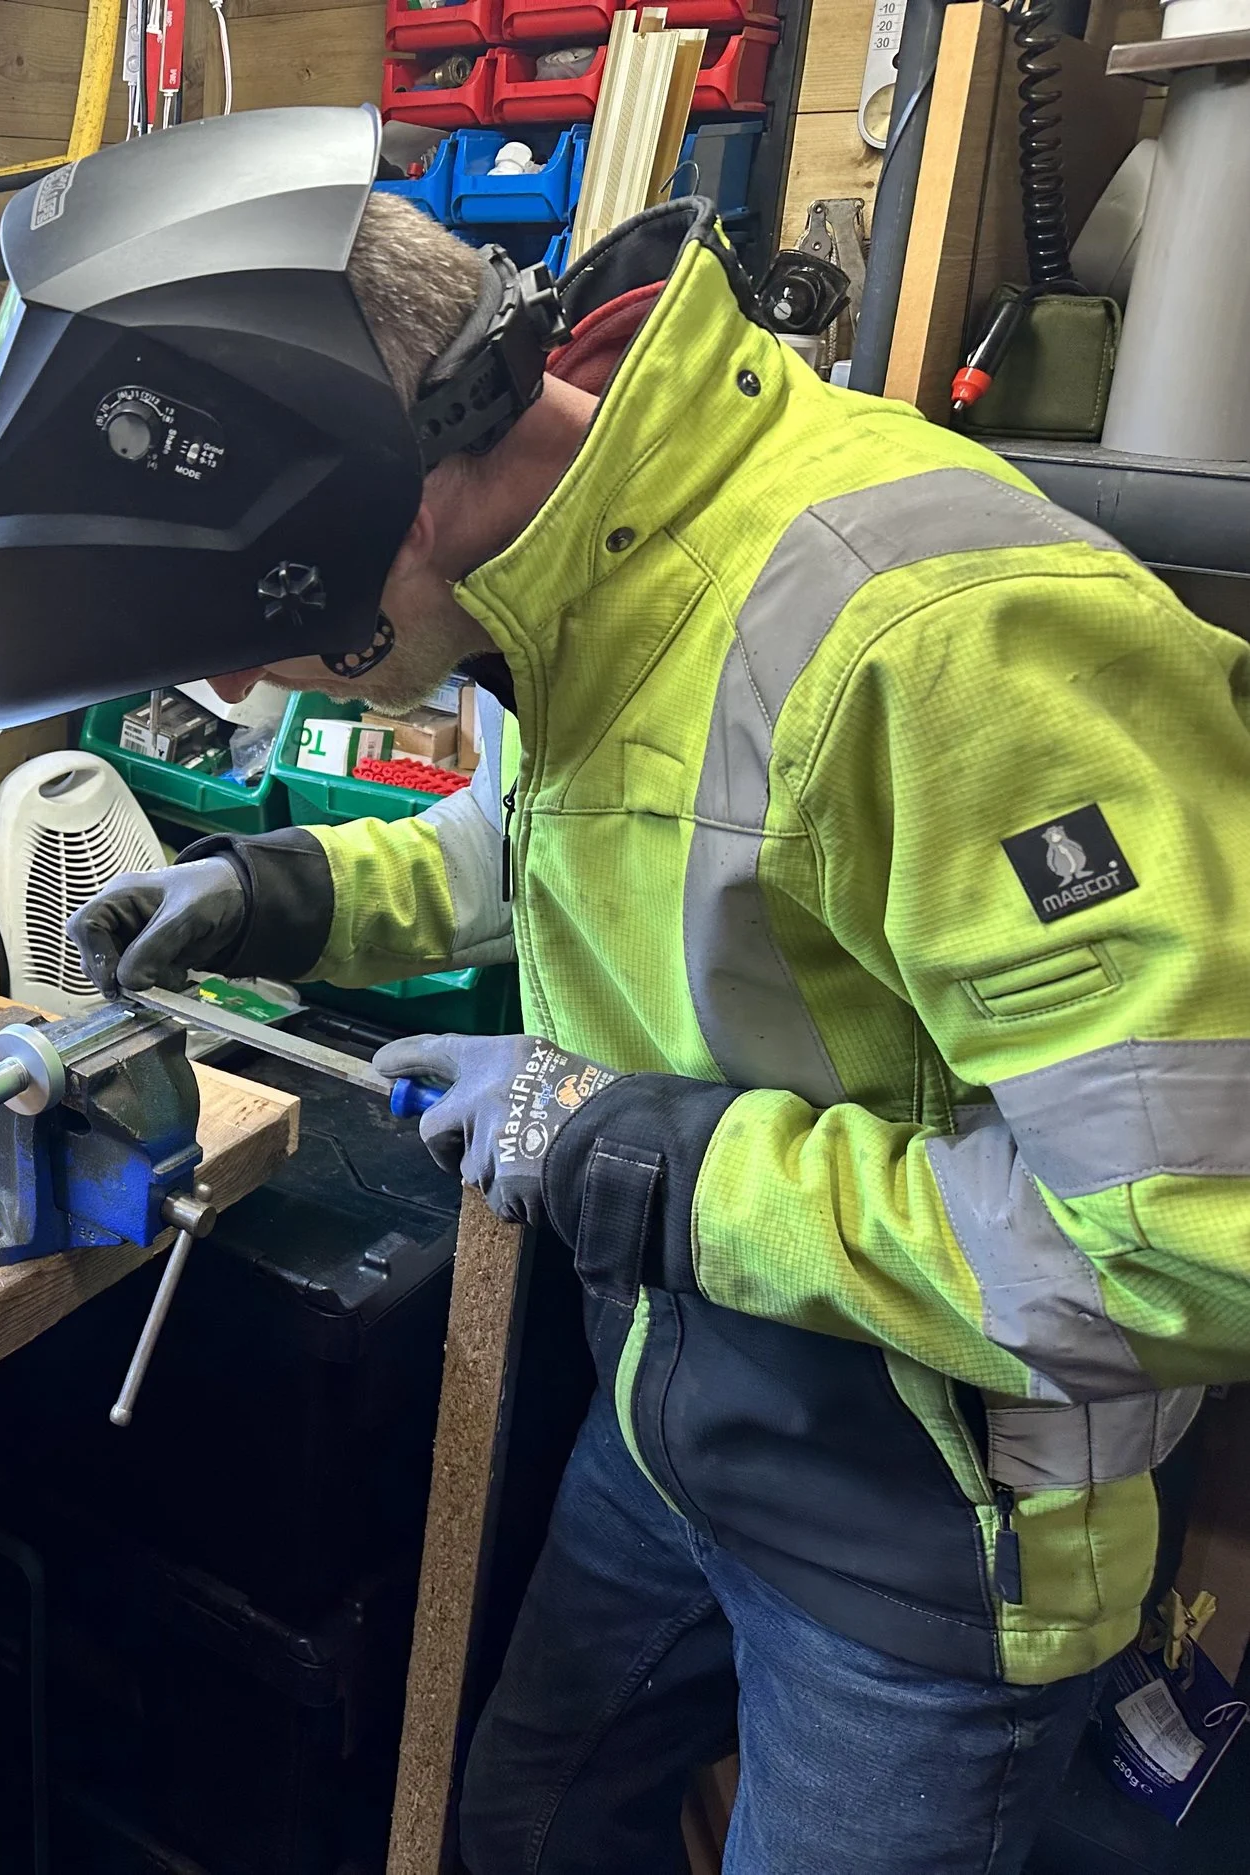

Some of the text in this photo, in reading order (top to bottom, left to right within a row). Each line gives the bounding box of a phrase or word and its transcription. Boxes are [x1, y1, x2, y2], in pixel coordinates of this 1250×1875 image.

[879, 3, 896, 14] -10
[876, 20, 892, 31] -20
[874, 38, 890, 48] -30
[203, 443, 225, 455] Grind
[199, 457, 217, 468] 9-13
[174, 465, 202, 480] MODE
[1042, 870, 1120, 912] MASCOT
[1112, 1755, 1139, 1787] 250g
